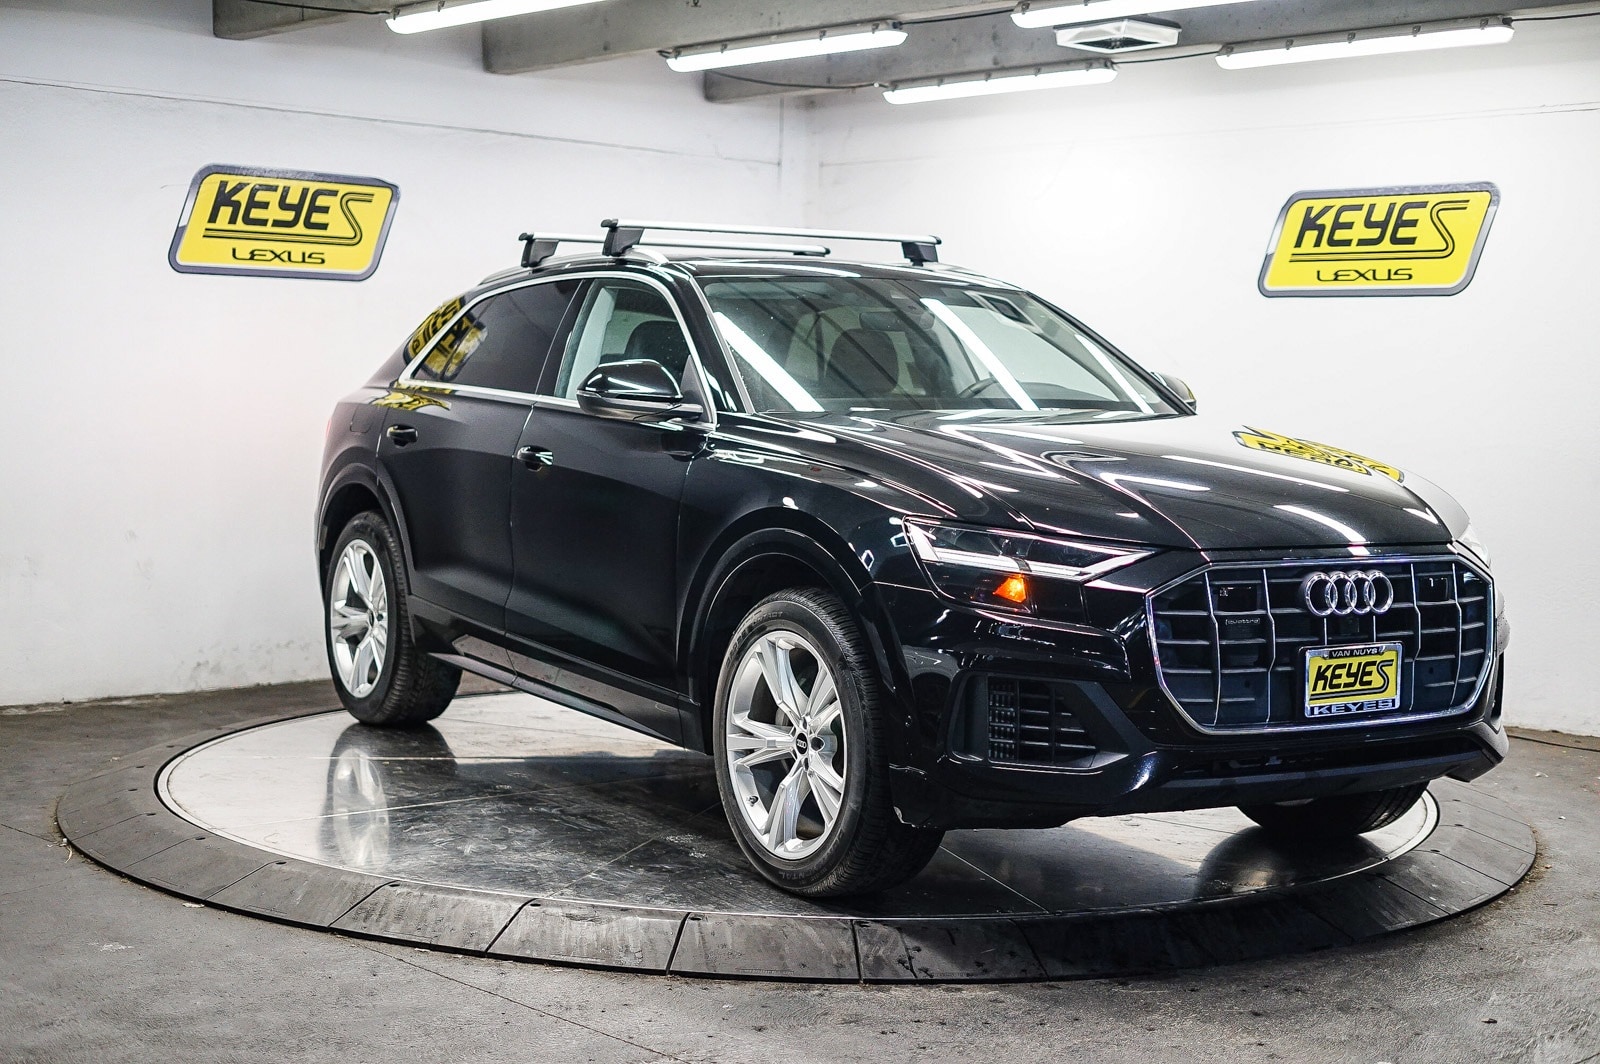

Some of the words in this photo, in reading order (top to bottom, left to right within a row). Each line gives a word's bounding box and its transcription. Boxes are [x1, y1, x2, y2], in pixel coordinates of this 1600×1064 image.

[203, 180, 374, 246] KEYES
[1289, 200, 1470, 262] KEYES
[231, 247, 326, 265] LEXUS
[1316, 268, 1413, 282] LEXUS
[1331, 650, 1351, 658] VAN
[1352, 647, 1378, 656] NUYS
[1309, 659, 1394, 701] KEYES
[1313, 699, 1393, 715] KEYES
